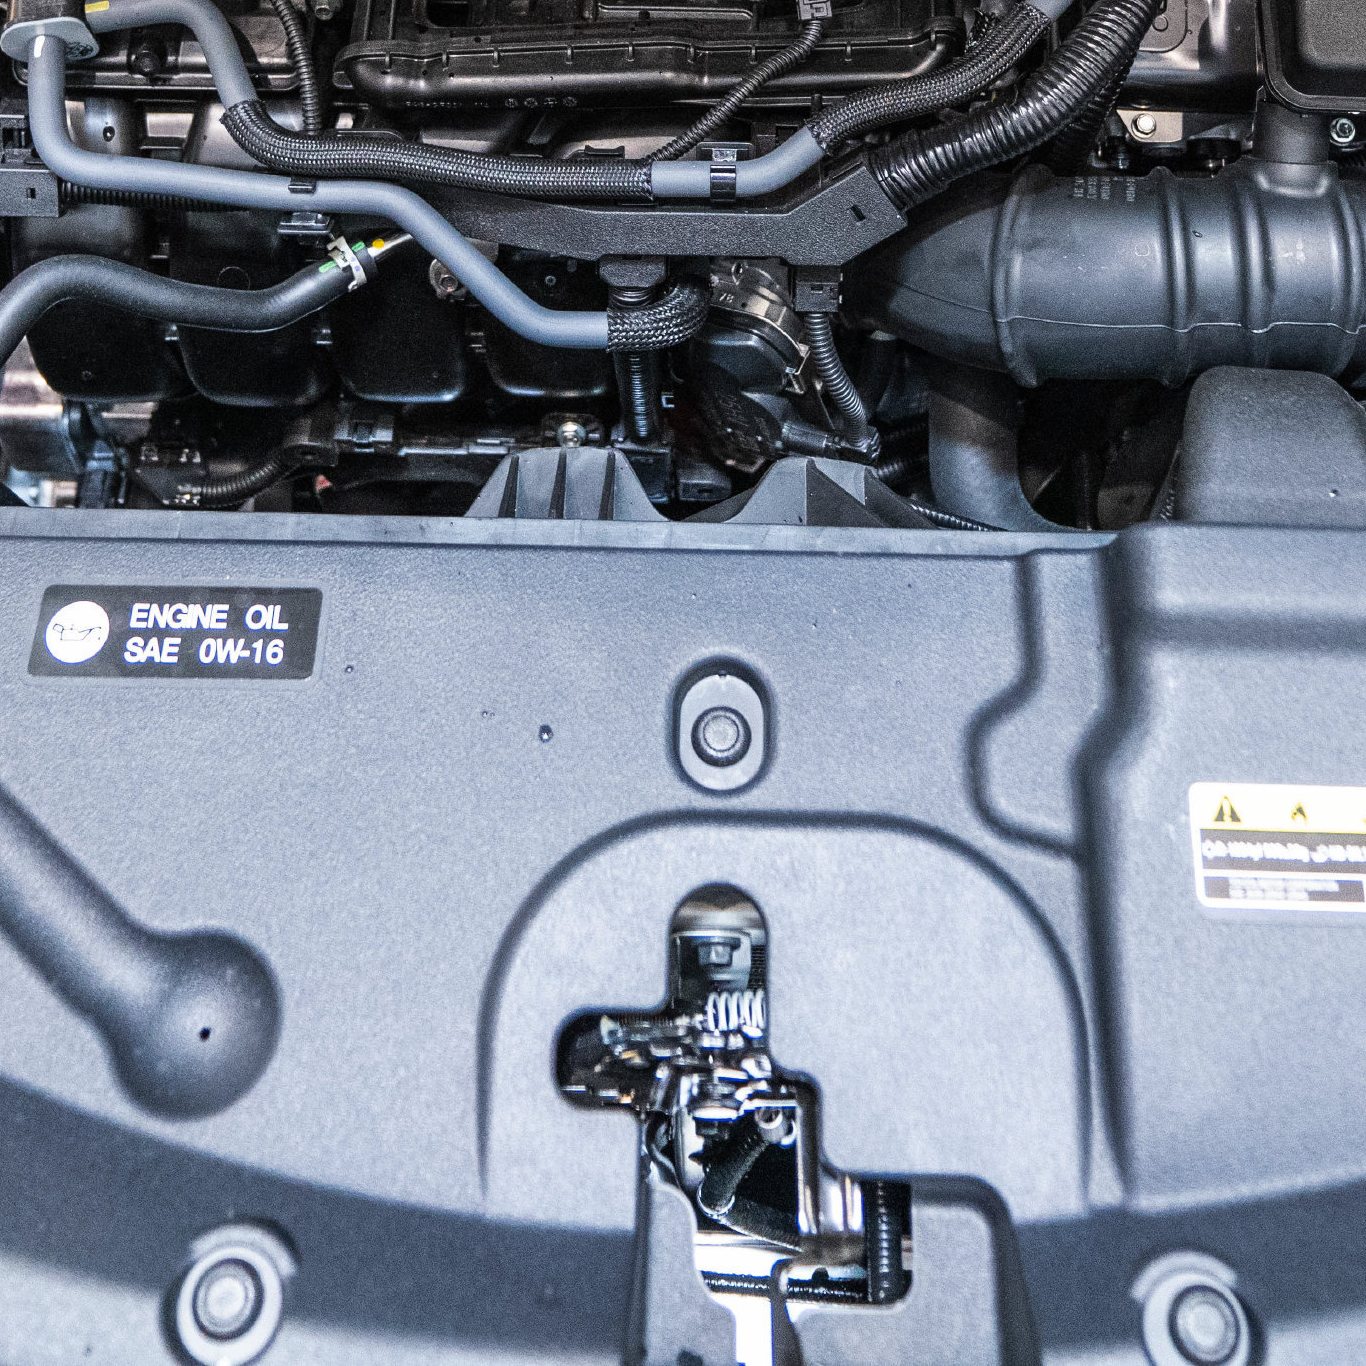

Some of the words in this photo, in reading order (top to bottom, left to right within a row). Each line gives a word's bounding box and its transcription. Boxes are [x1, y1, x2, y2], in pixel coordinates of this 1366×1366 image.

[129, 603, 229, 630] ENGINE
[244, 604, 288, 631] OIL
[124, 636, 181, 664] SAE
[198, 638, 284, 666] 0W-16
